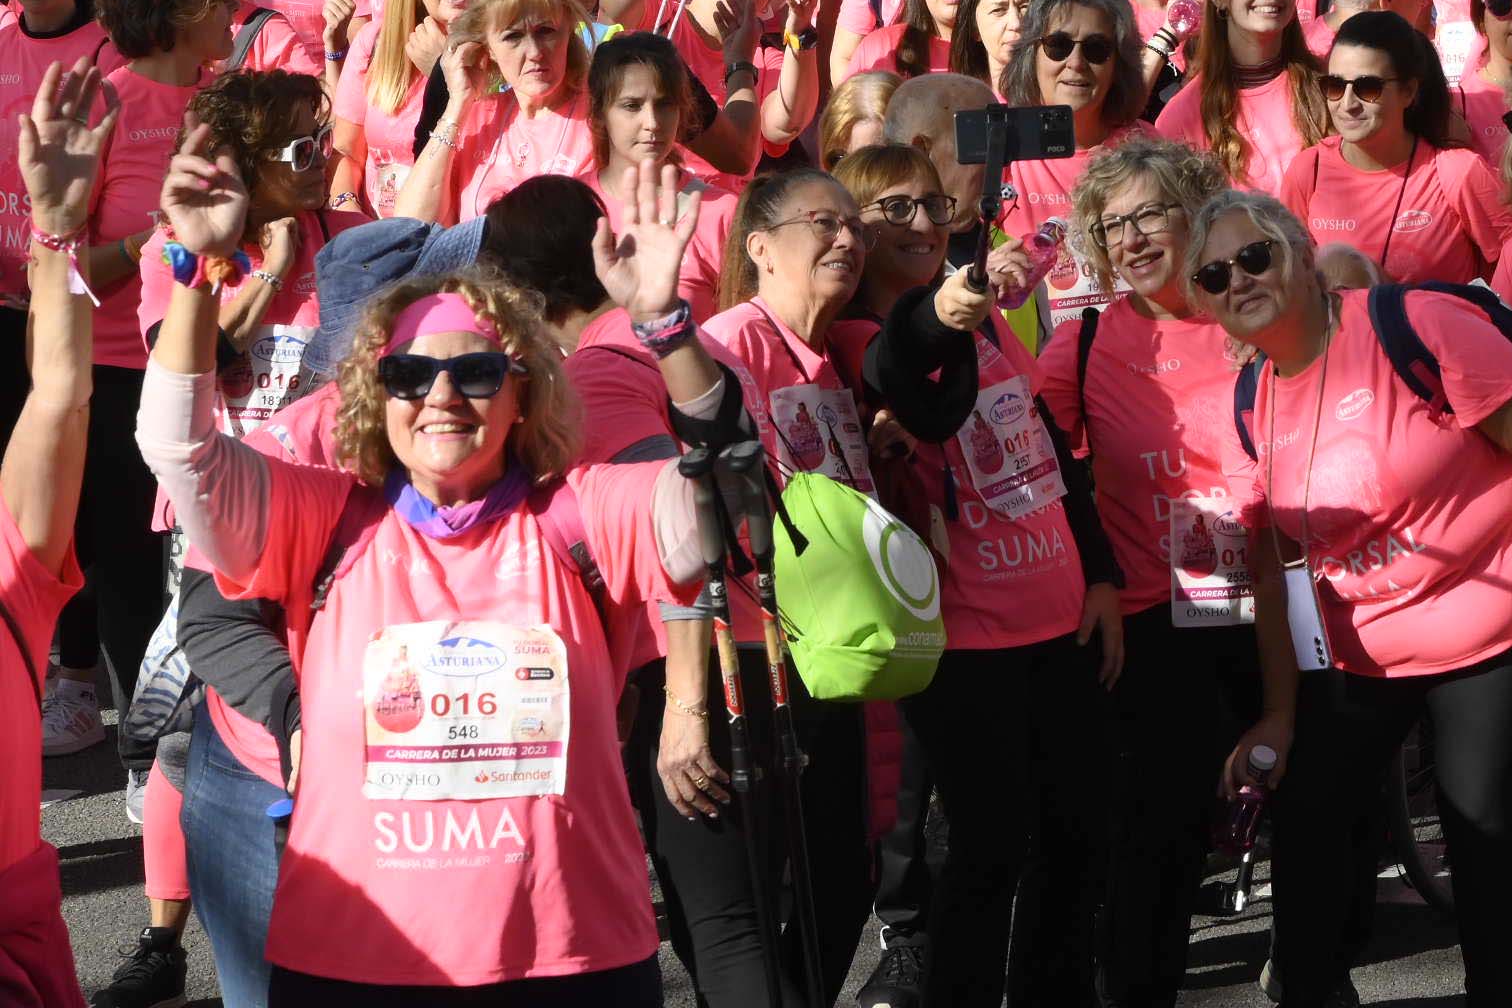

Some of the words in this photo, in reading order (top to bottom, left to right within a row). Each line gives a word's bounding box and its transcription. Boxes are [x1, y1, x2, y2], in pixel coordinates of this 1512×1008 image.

[1312, 219, 1356, 231] OYSHO
[1056, 297, 1090, 308] CARRERA
[256, 372, 300, 389] 016
[1004, 429, 1030, 453] 016
[1140, 448, 1188, 481] TU
[977, 527, 1066, 571] SUMA
[1221, 549, 1248, 567] 01
[1190, 589, 1229, 599] CARRERA
[1186, 607, 1231, 619] OYSHO
[514, 645, 551, 656] SUMA
[428, 653, 501, 667] ASTURIANA
[430, 692, 498, 718] 016
[447, 725, 480, 740] 548
[385, 749, 441, 760] CARRERA
[442, 748, 460, 760] DE
[460, 748, 477, 759] LA
[478, 747, 518, 758] MUJER
[521, 746, 548, 756] 2023
[381, 772, 441, 787] OYSHO
[490, 770, 553, 784] Santander
[374, 807, 527, 854] SUMA
[375, 857, 421, 870] CARRERA
